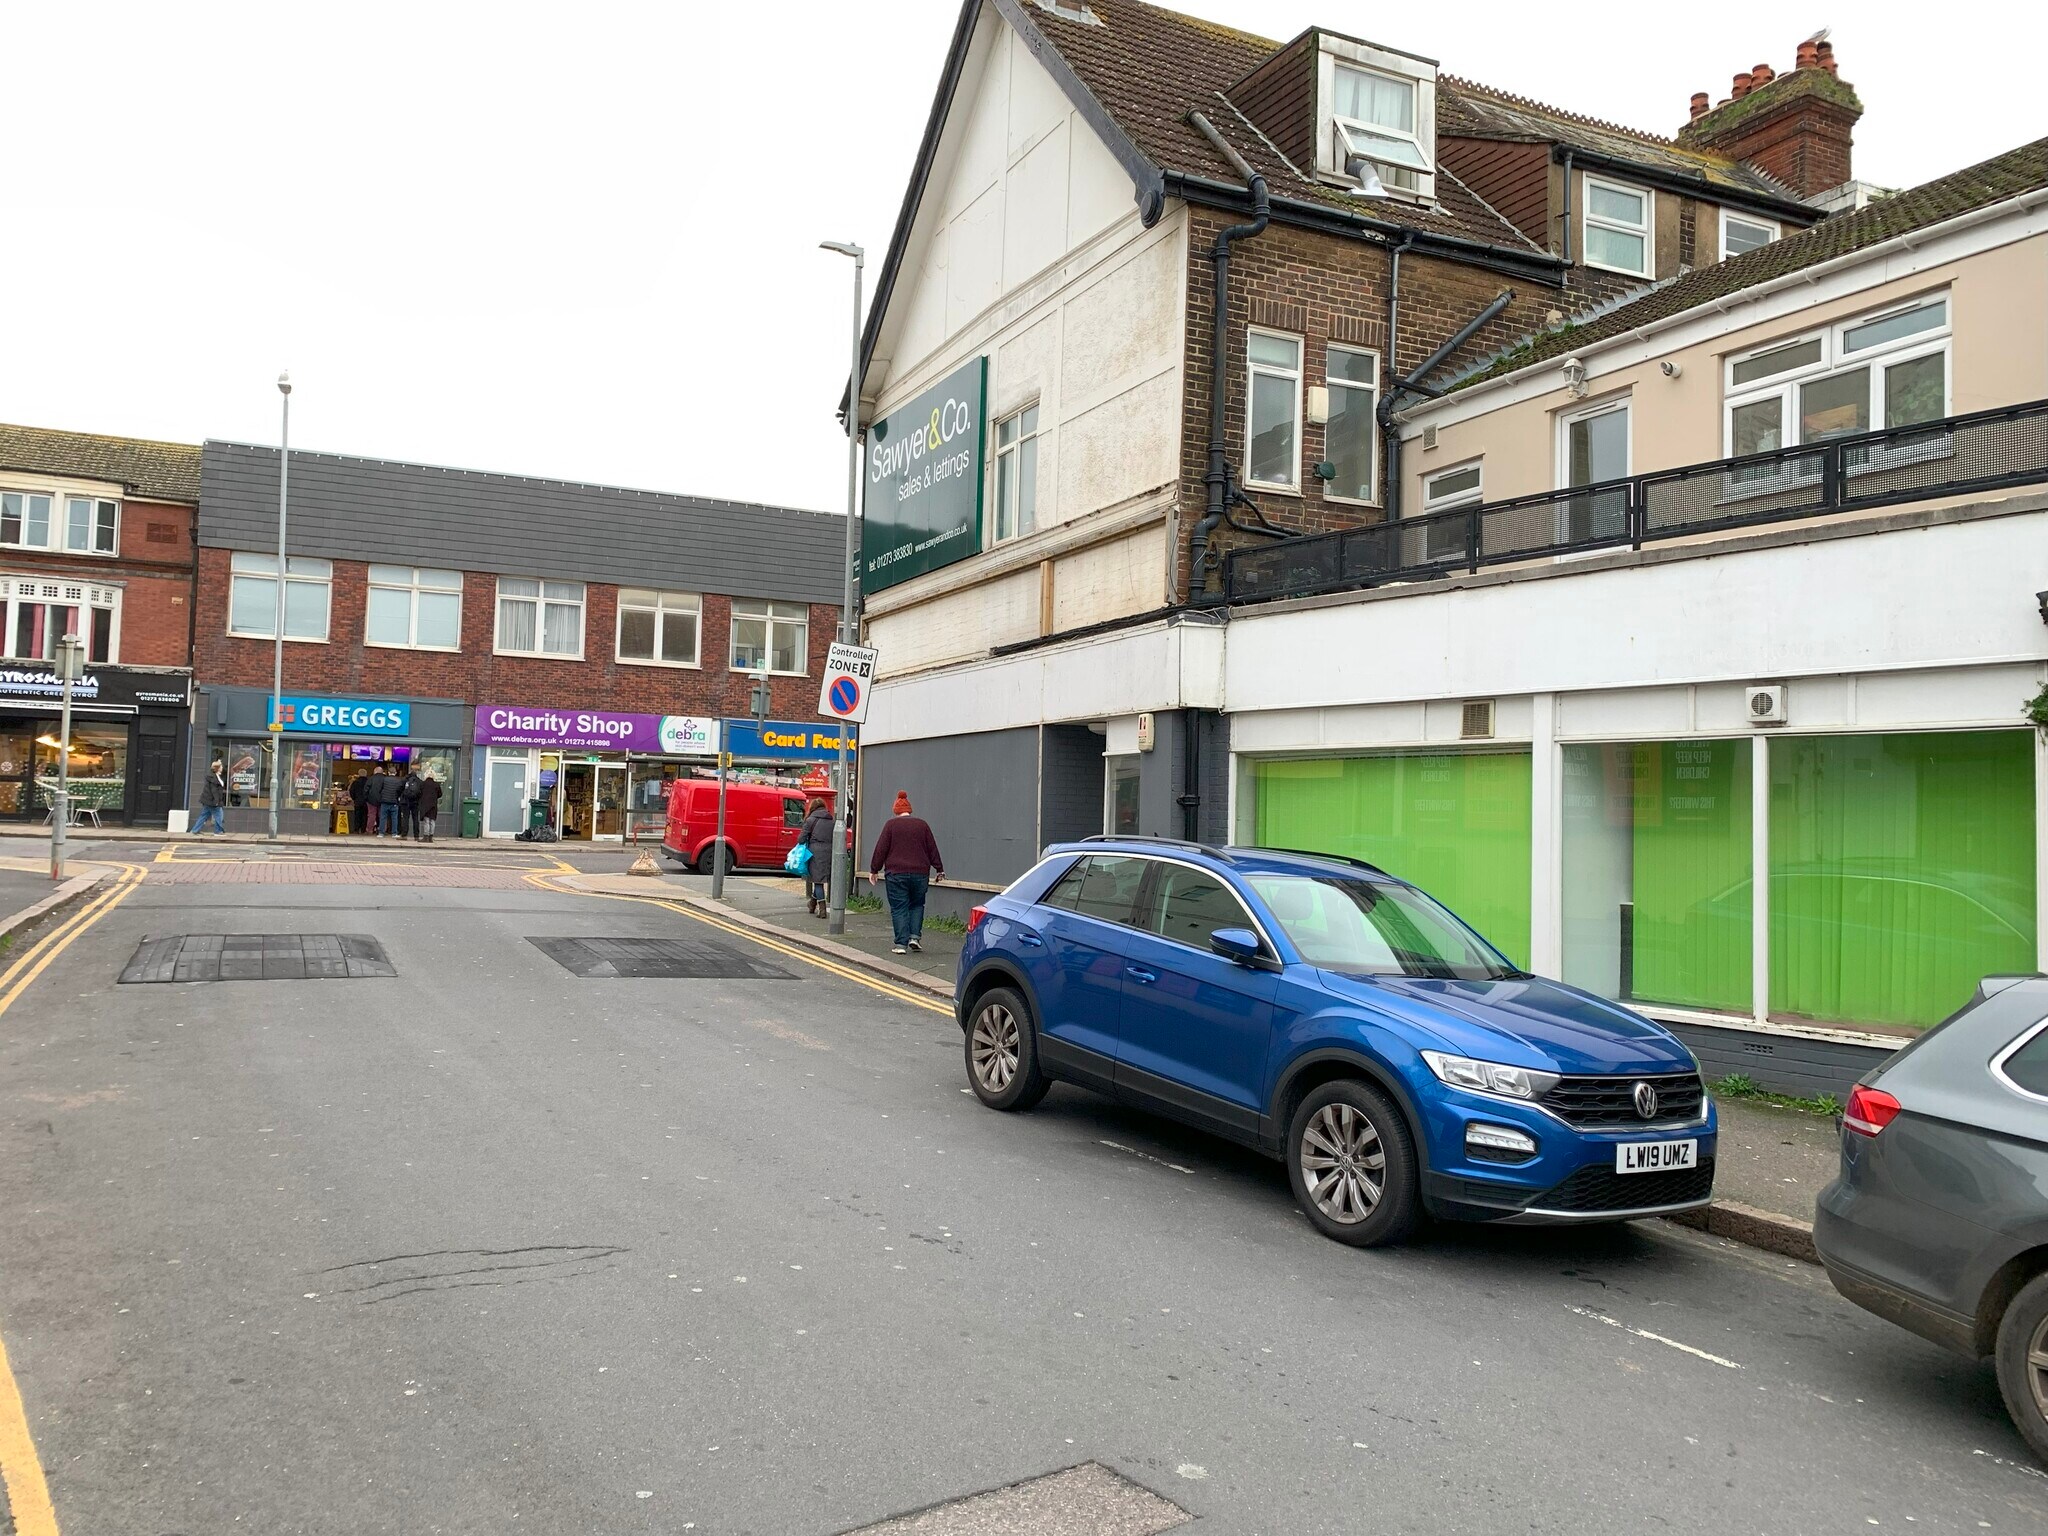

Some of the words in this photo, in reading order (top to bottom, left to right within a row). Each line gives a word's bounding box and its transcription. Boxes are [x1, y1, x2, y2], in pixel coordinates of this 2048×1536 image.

[871, 398, 971, 483] Sawyer&Co.
[898, 475, 922, 502] sales
[923, 465, 932, 488] &
[933, 449, 970, 484] lettings
[876, 552, 893, 568] 01273
[893, 543, 913, 562] 383830
[831, 646, 874, 661] Controlled
[829, 658, 859, 673] ZONE
[860, 663, 870, 677] X
[302, 704, 402, 729] GREGGS
[490, 710, 572, 736] Charity
[576, 714, 633, 739] Shop
[491, 736, 557, 745] www.debra.org.uk
[667, 728, 706, 741] debra
[763, 731, 806, 748] Card
[502, 748, 511, 756] 77
[1626, 1145, 1660, 1169] LW19
[1663, 1143, 1690, 1166] UMZ
